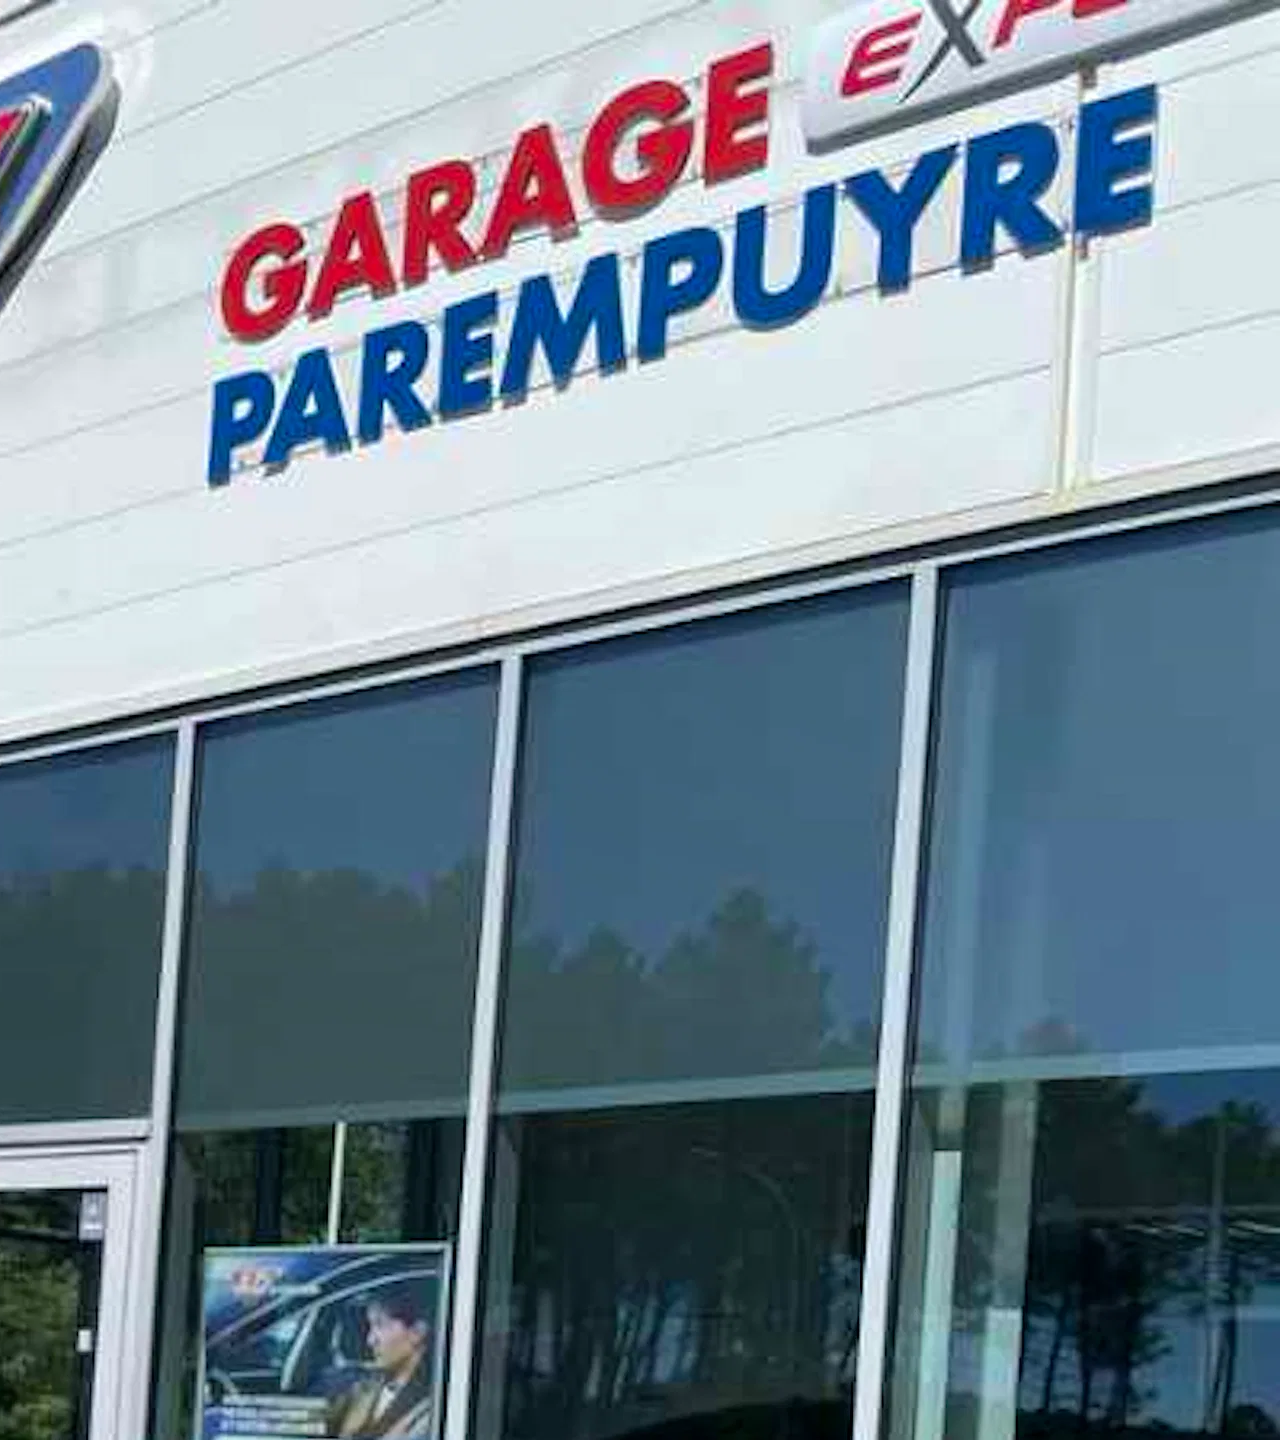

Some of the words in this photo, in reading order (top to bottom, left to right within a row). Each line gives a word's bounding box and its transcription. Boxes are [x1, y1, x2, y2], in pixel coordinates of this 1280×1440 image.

[220, 43, 774, 343] GARAGE
[838, 0, 1130, 102] EXP
[208, 83, 1158, 487] PAREMPUYRE
